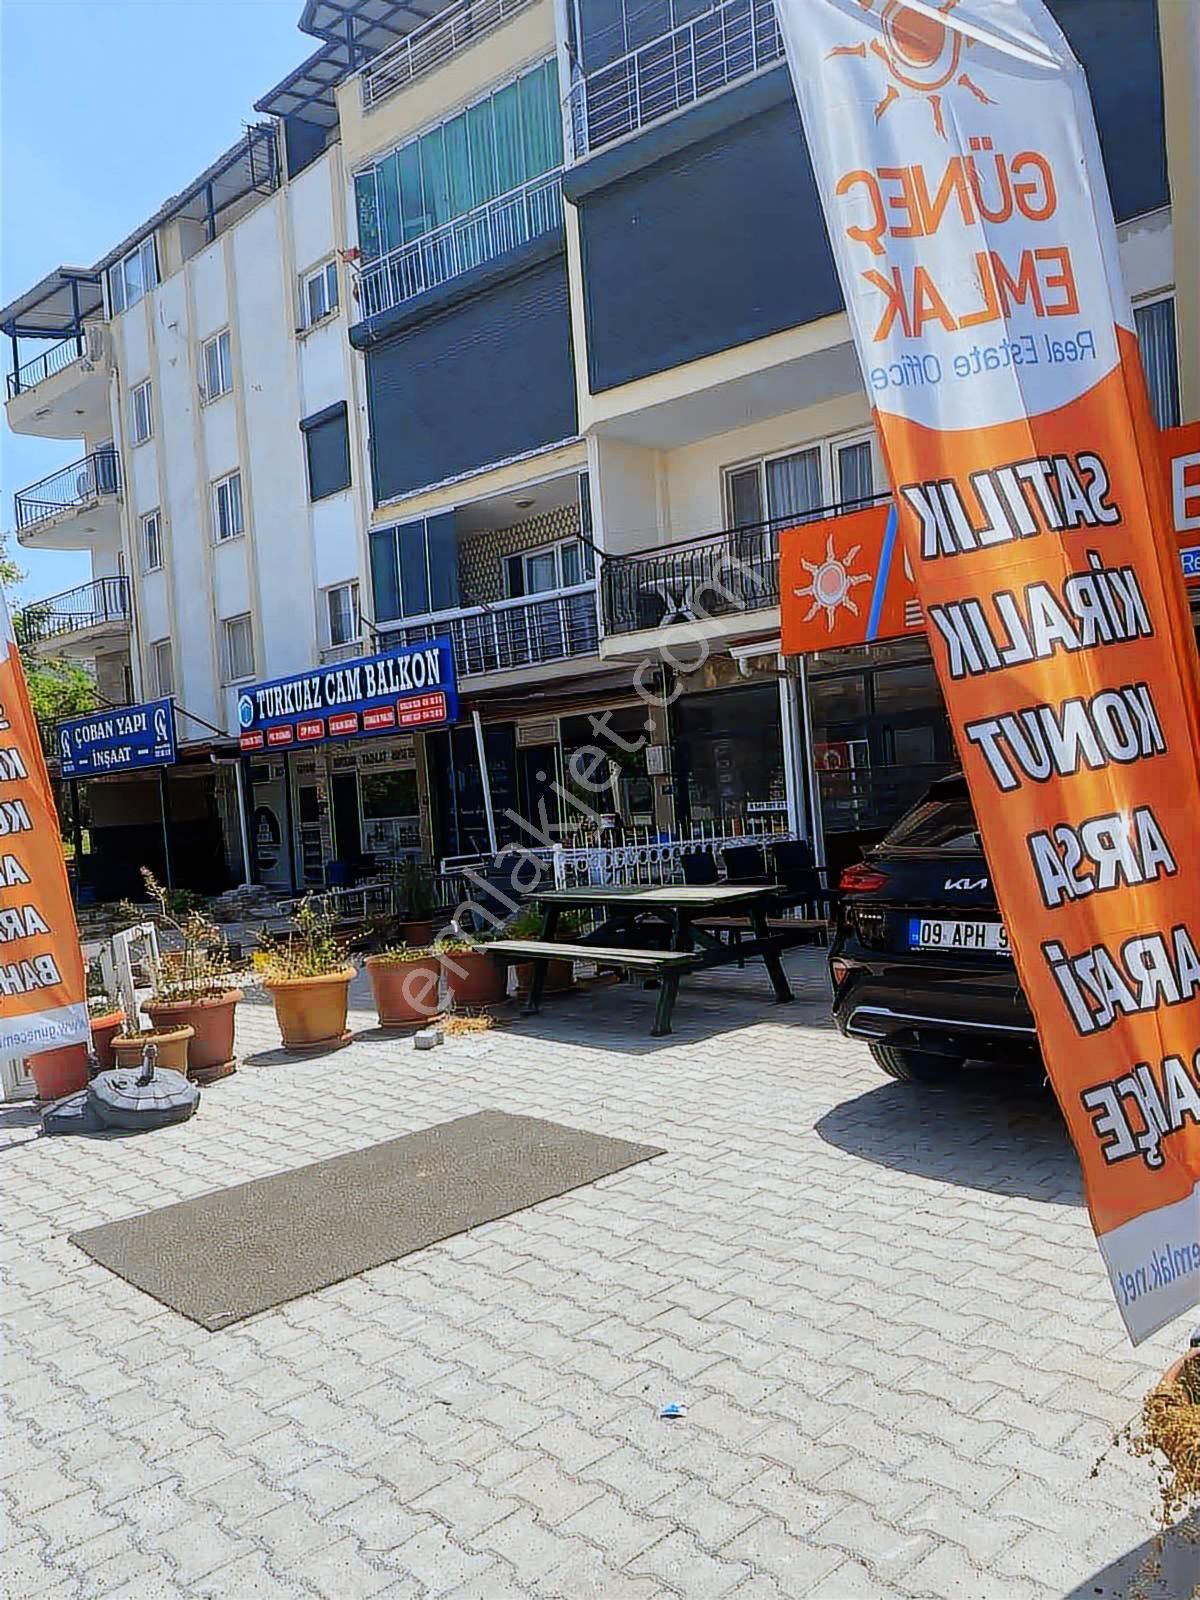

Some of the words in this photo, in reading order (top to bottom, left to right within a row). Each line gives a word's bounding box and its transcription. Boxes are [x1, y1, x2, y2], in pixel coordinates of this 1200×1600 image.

[256, 677, 323, 719] TURKUAZ
[325, 667, 362, 706] CAM
[365, 648, 441, 698] BALKON
[75, 720, 114, 749] ÇOBAN
[116, 712, 147, 735] YAPI
[92, 746, 132, 769] İNŞAAT
[944, 878, 988, 890] KIA
[922, 922, 943, 944] 09
[952, 924, 986, 947] APH
[998, 926, 1009, 949] 9
